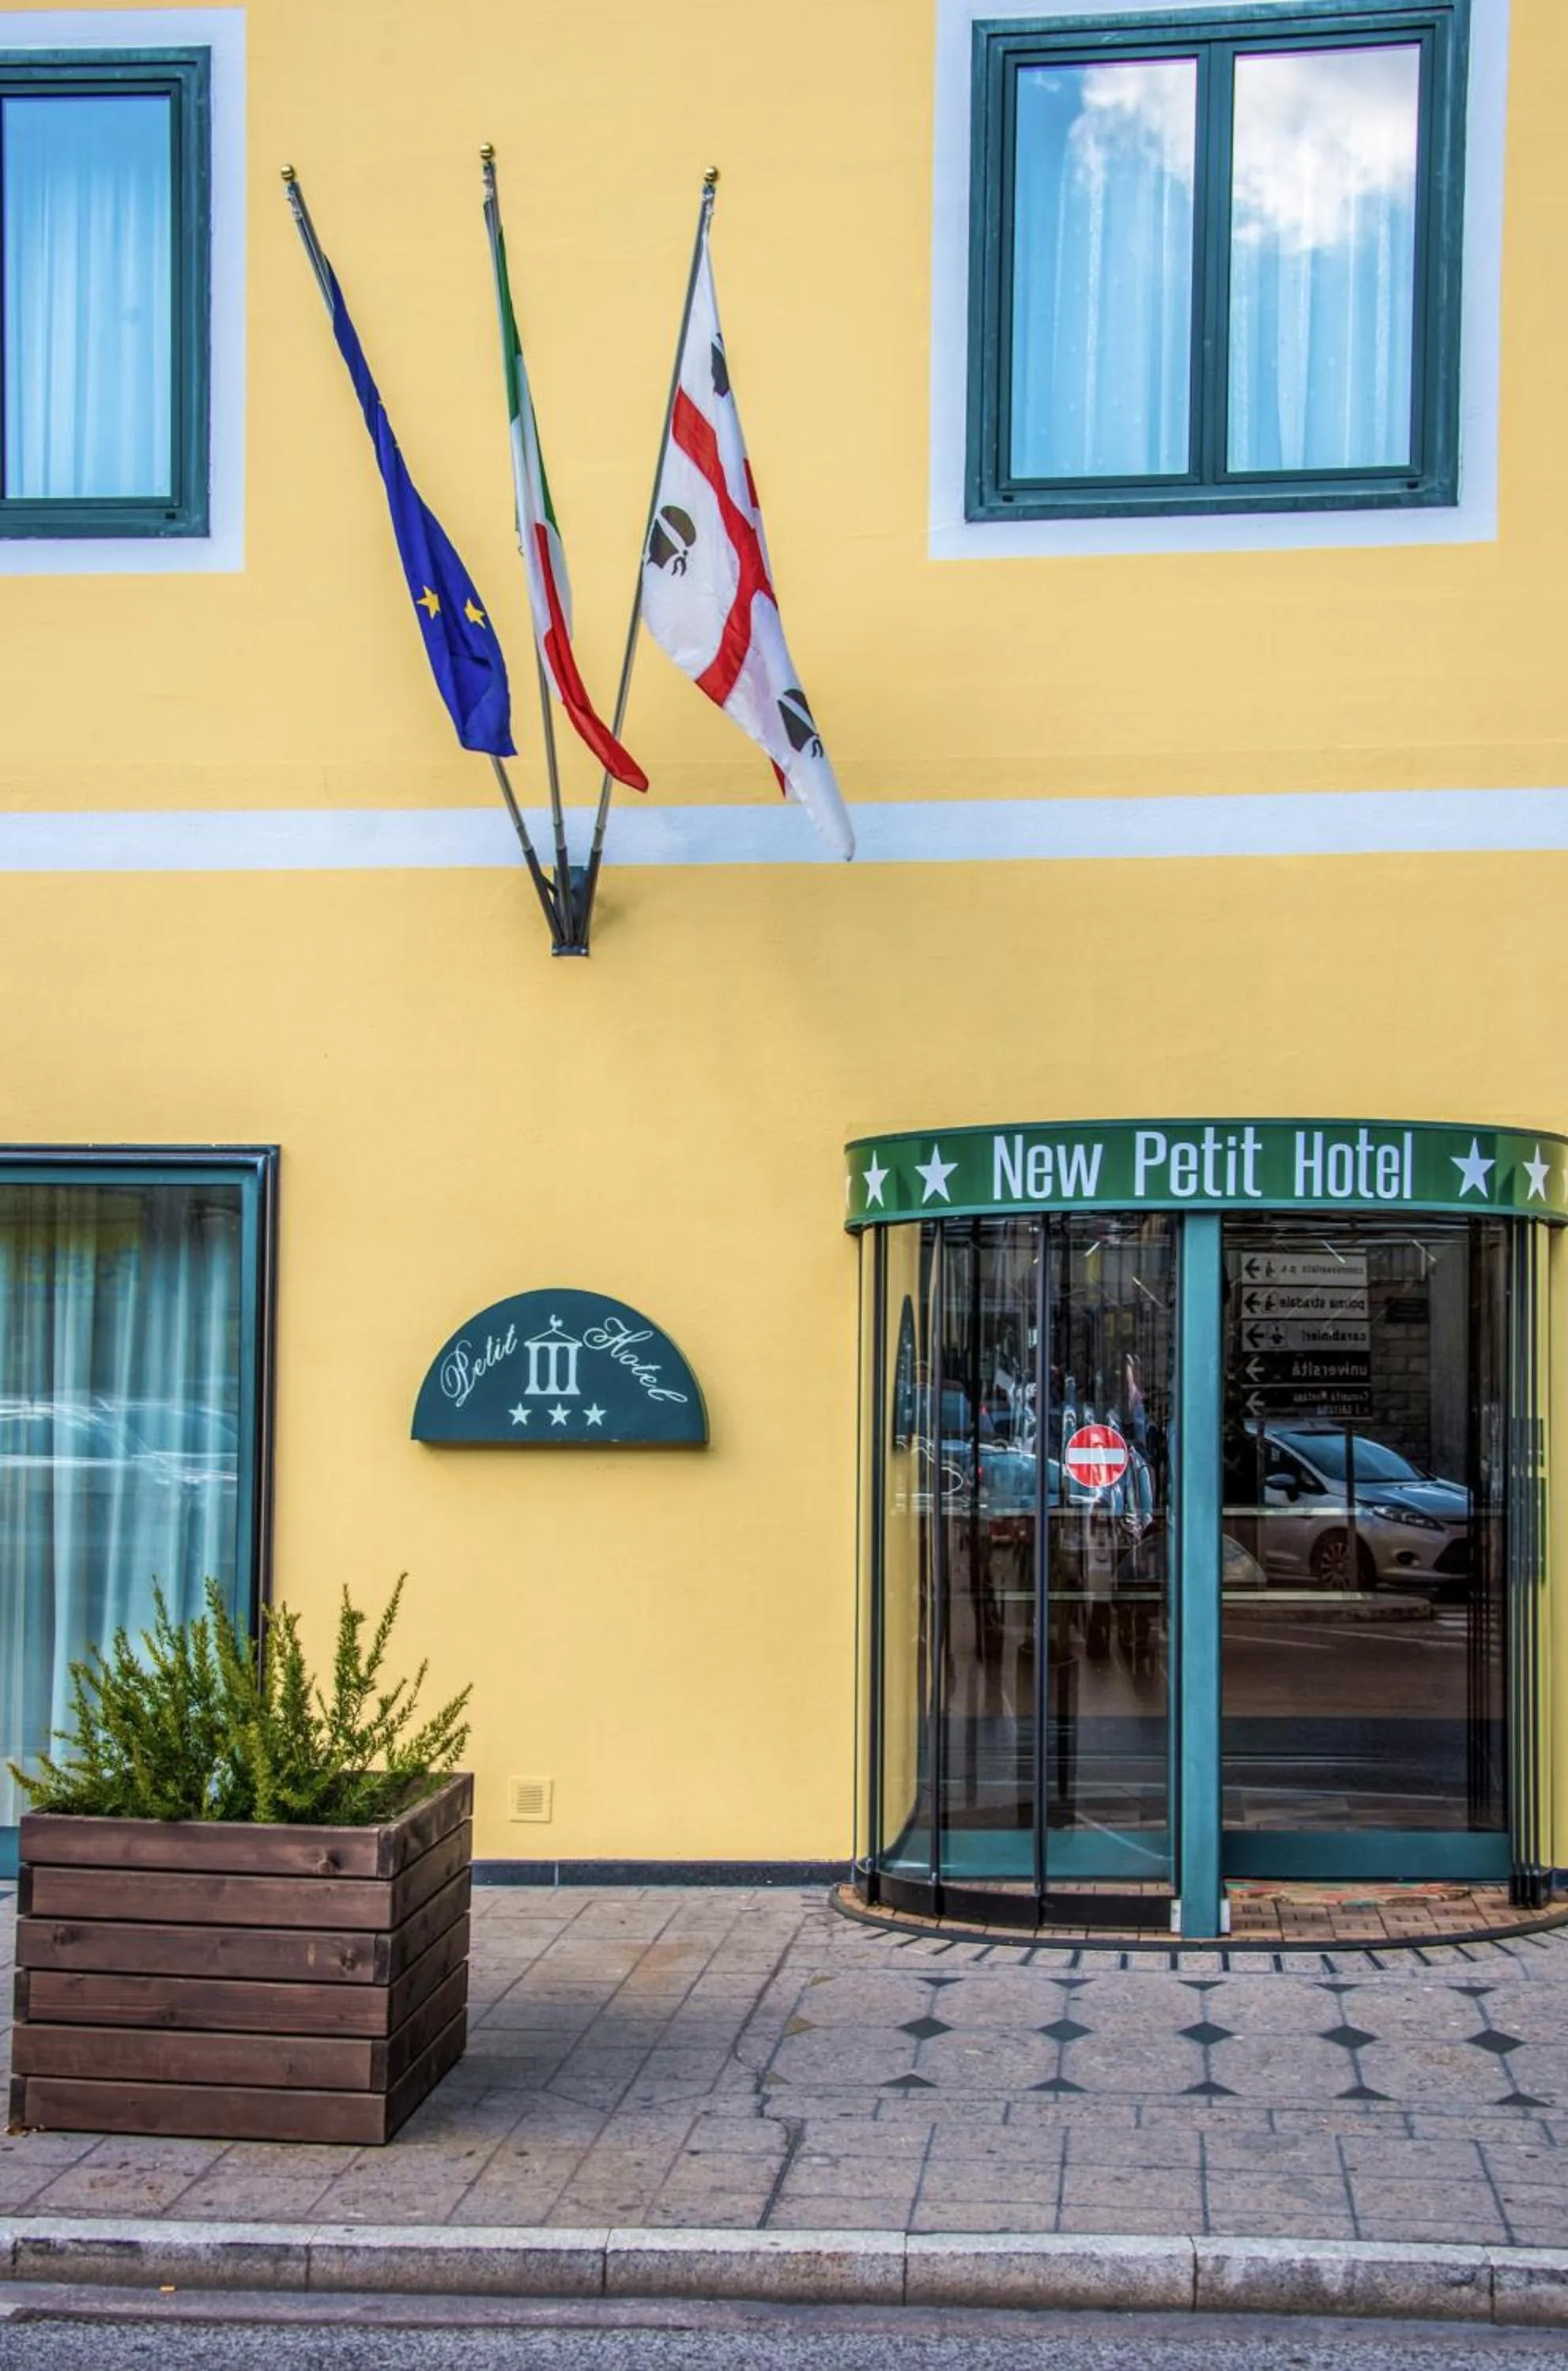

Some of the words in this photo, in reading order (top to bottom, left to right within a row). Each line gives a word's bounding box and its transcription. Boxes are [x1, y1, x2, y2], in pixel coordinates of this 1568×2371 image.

[993, 1135, 1103, 1200] New
[1135, 1127, 1262, 1197] Petit
[1295, 1131, 1412, 1199] Hotel
[440, 1323, 518, 1408] Petit
[582, 1317, 688, 1403] Hotel
